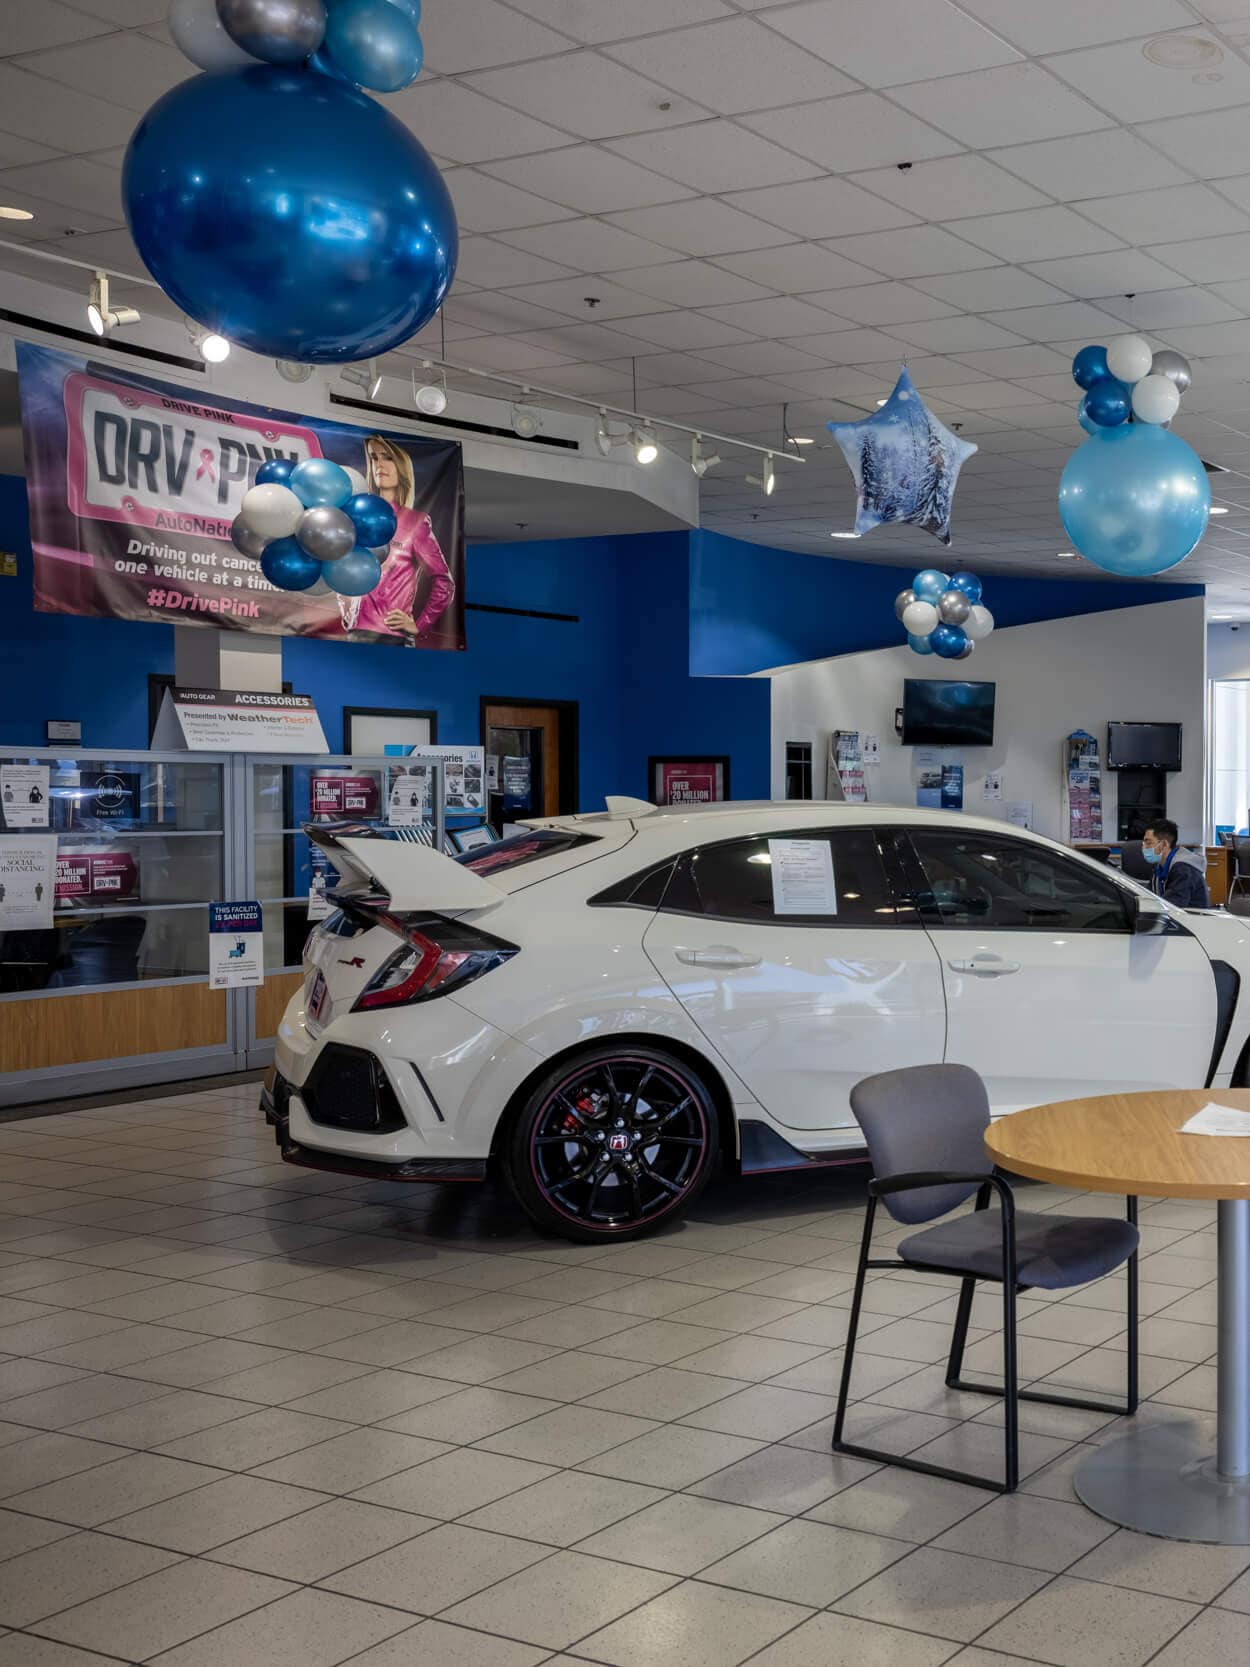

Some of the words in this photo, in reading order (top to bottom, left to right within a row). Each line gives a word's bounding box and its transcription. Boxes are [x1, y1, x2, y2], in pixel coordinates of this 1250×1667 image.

[161, 399, 201, 416] DRIVE
[203, 407, 236, 424] PINK
[94, 410, 195, 496] DRV
[127, 539, 187, 564] Driving
[191, 552, 217, 567] out
[222, 556, 263, 573] cance
[114, 560, 148, 574] one
[153, 564, 209, 583] vehicle
[212, 572, 230, 586] at
[233, 575, 243, 587] a
[146, 588, 261, 618] #DrivePink
[235, 694, 310, 706] ACCESSORIES
[183, 711, 219, 721] Presented
[219, 713, 227, 722] by
[227, 713, 314, 724] WeatherTech
[672, 781, 689, 790] OVER
[682, 790, 709, 800] MILLION
[231, 905, 257, 913] FACILITY
